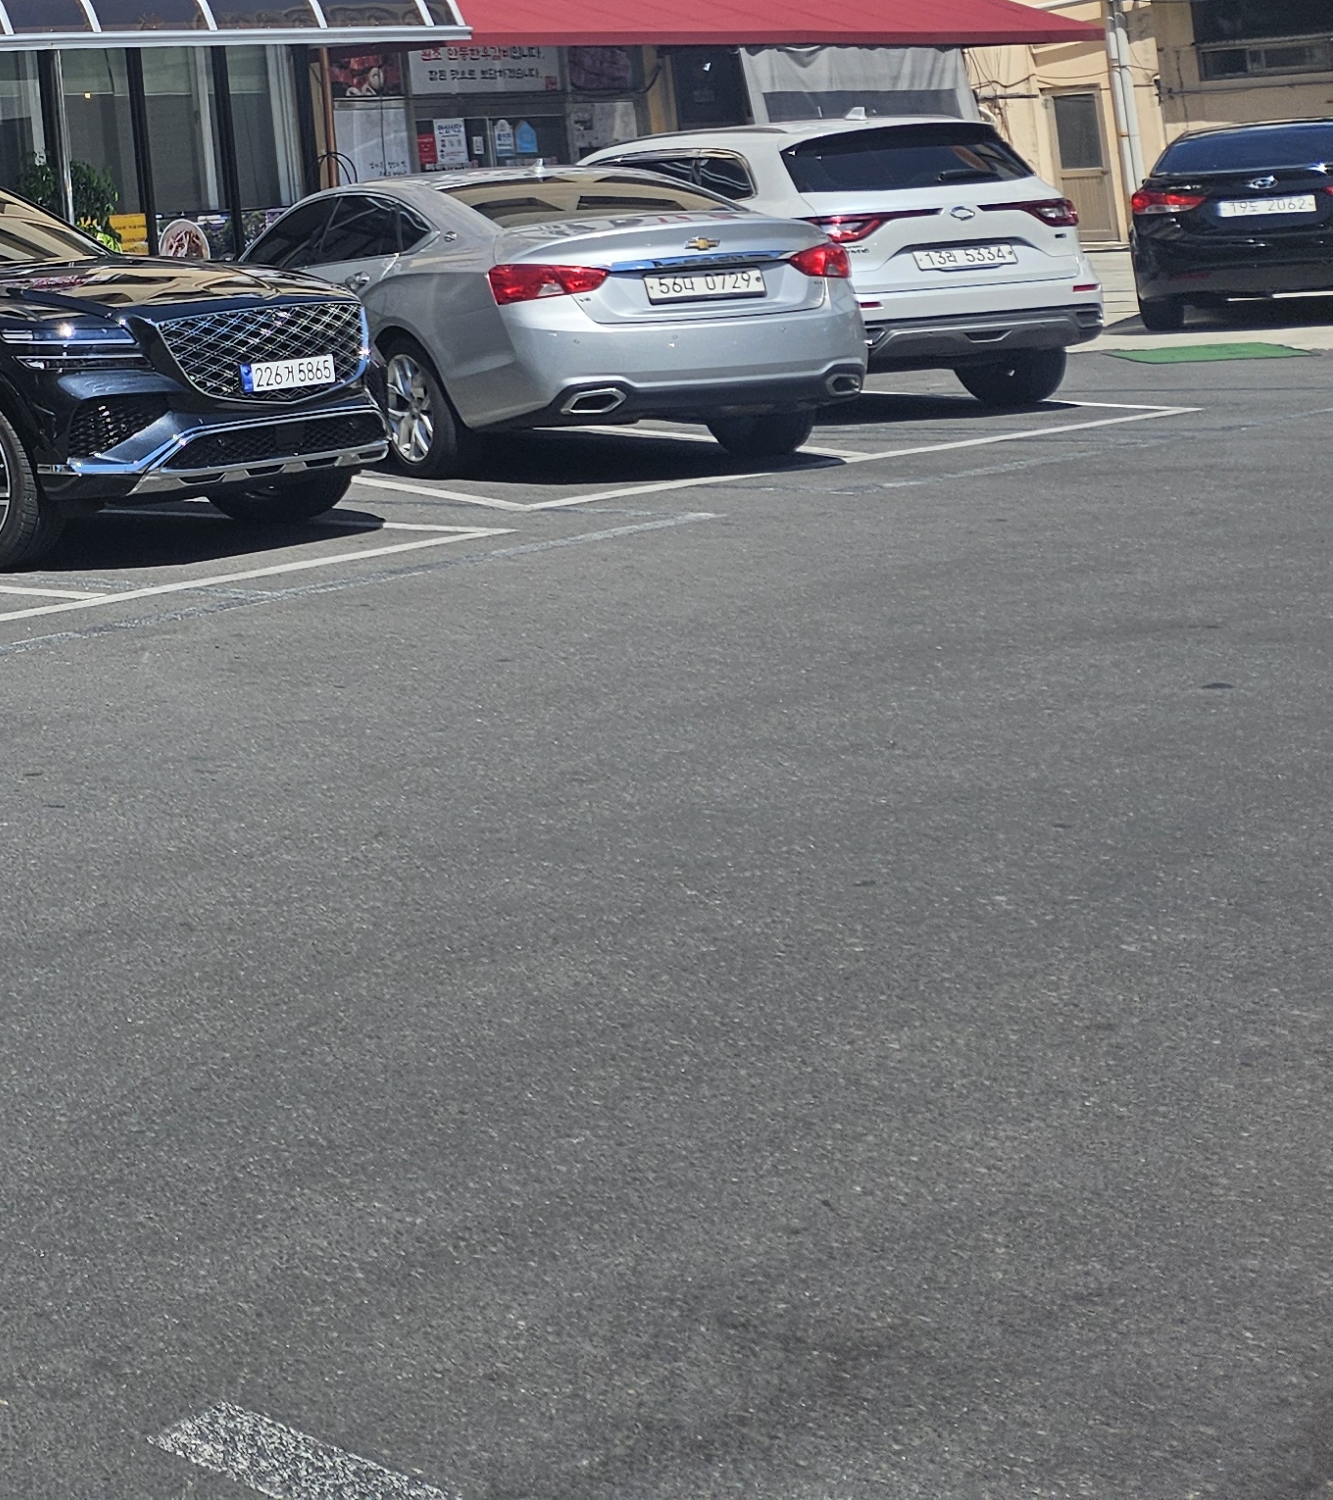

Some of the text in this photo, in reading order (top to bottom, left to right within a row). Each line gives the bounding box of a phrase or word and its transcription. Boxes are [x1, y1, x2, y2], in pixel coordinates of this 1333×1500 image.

[966, 247, 1006, 263] 5334
[705, 272, 751, 291] 0729
[298, 359, 331, 382] 5865
